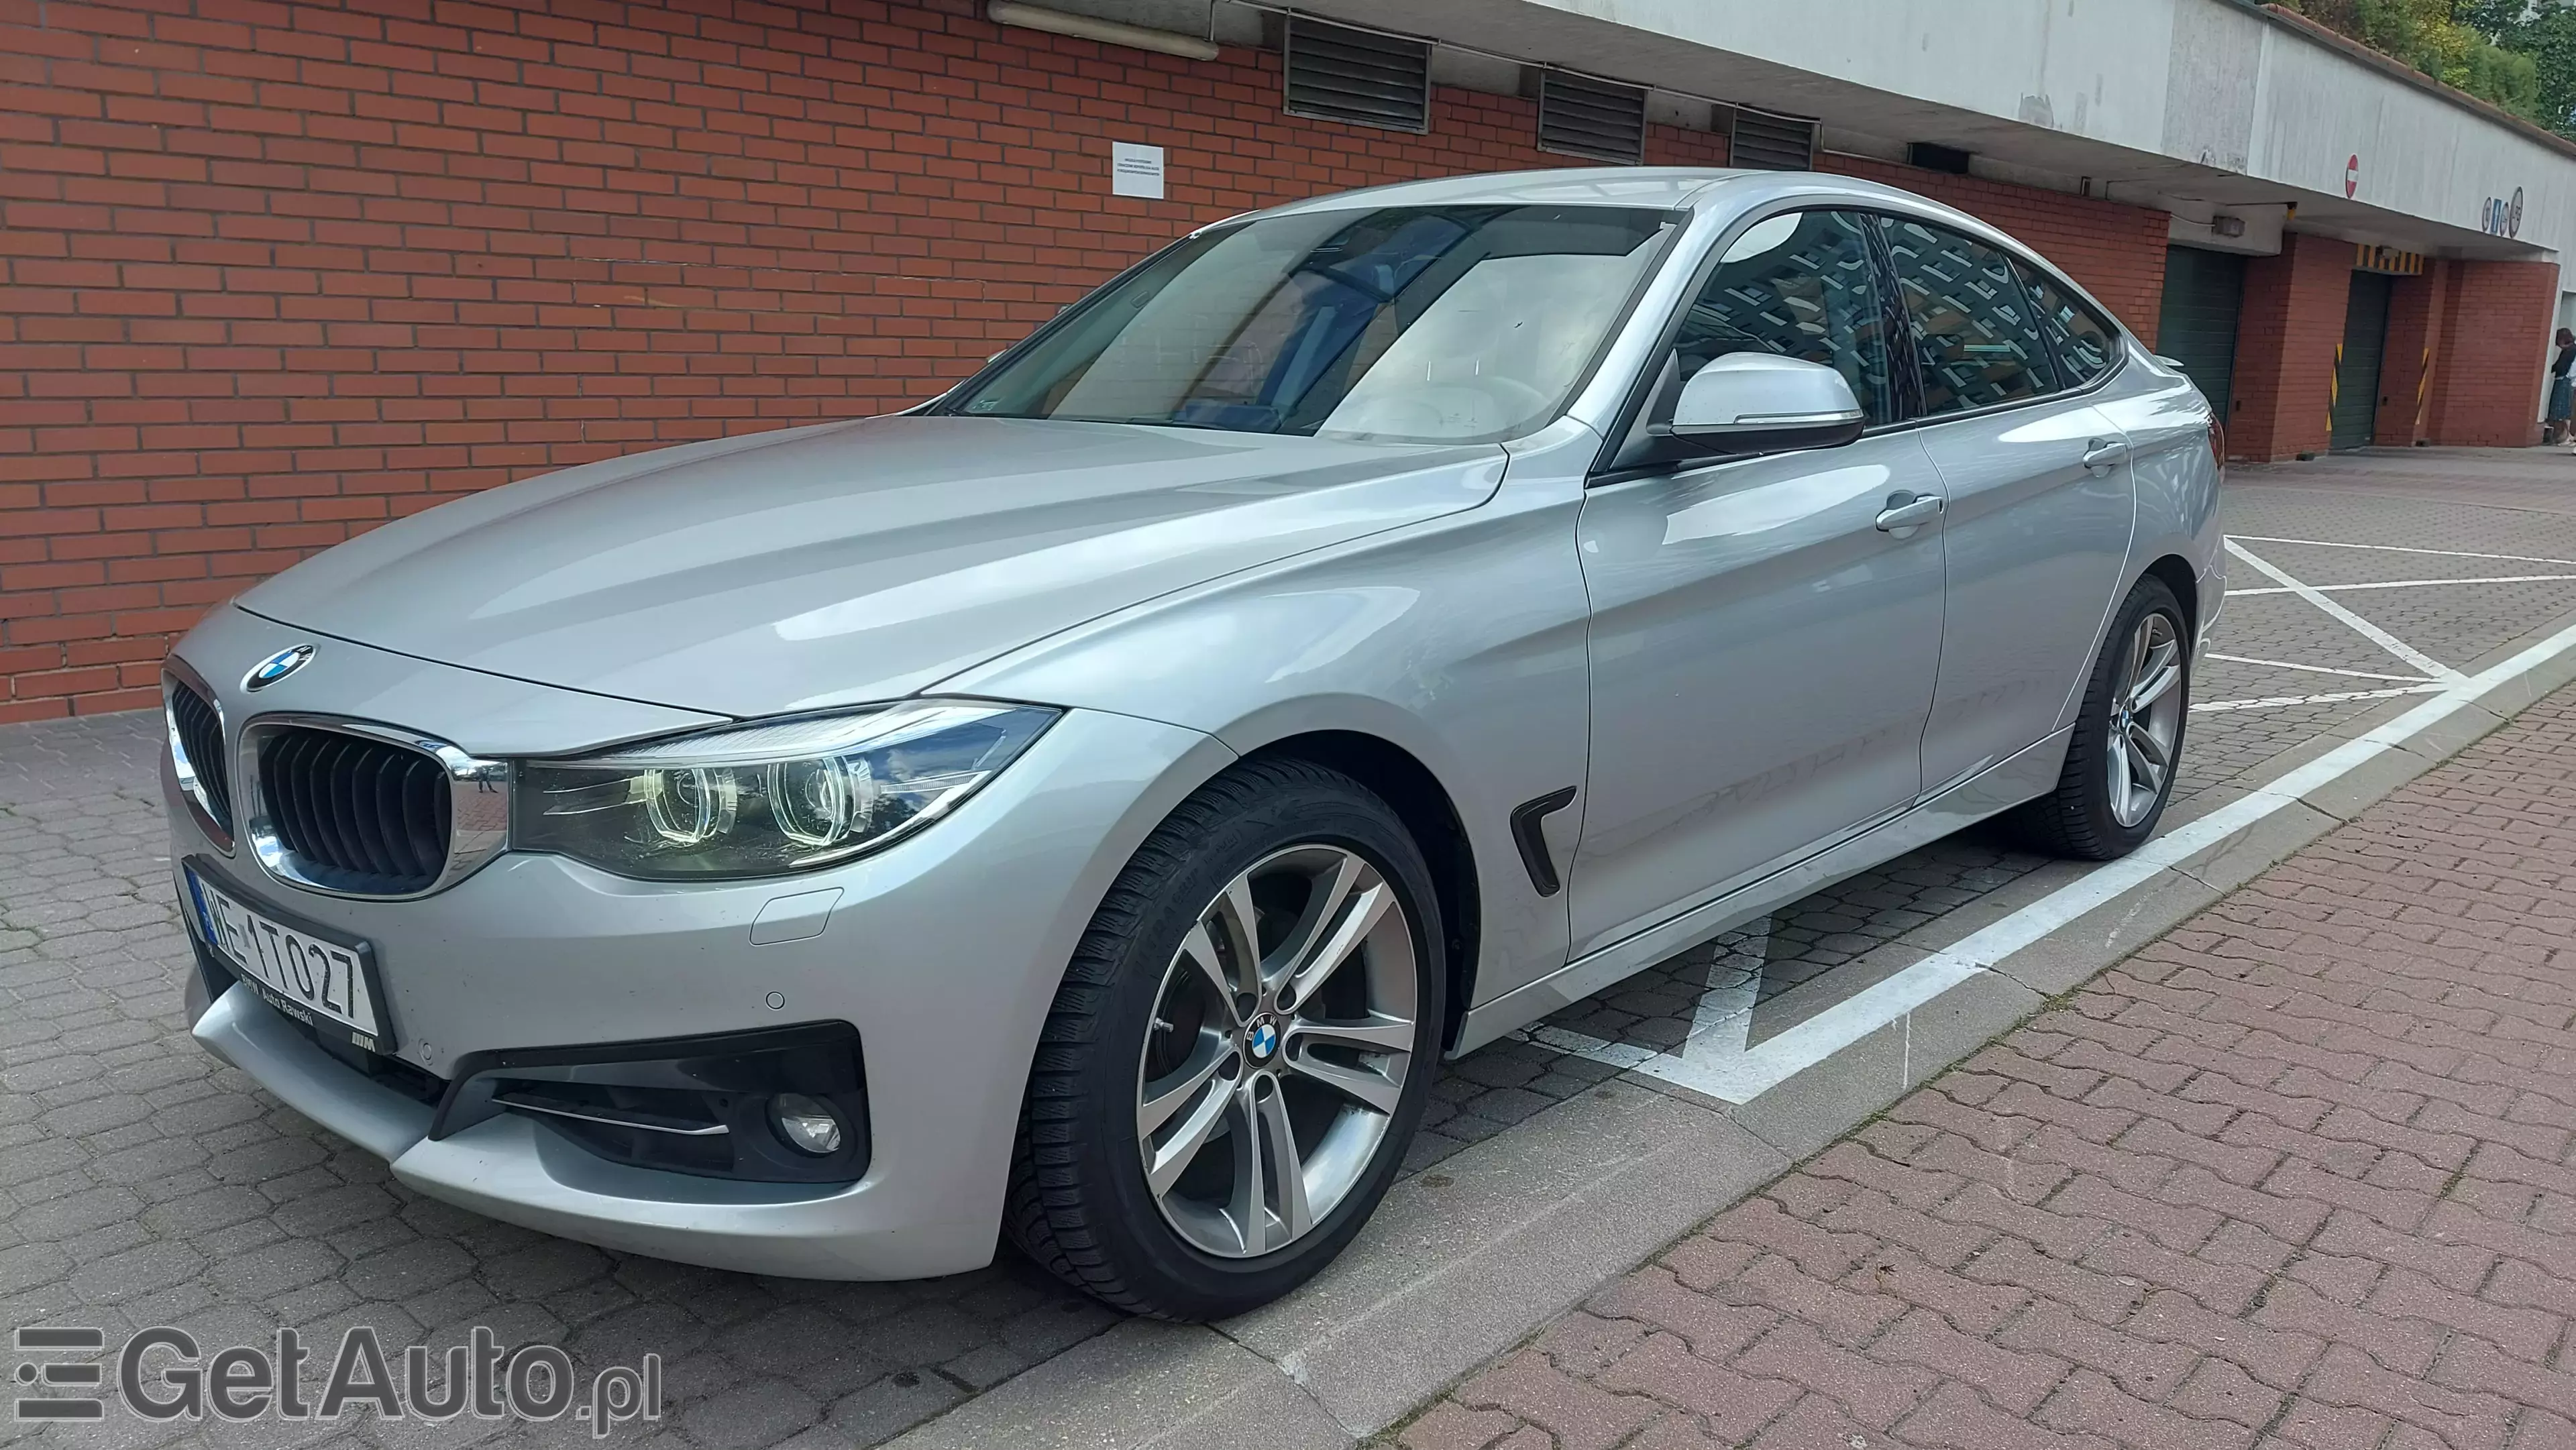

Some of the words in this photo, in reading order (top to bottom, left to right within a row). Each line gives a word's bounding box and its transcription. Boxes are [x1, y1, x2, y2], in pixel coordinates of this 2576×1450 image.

[241, 972, 260, 995] BMW
[261, 987, 280, 1009] Auto
[281, 999, 314, 1026] Rawski
[1246, 1015, 1278, 1042] BMW
